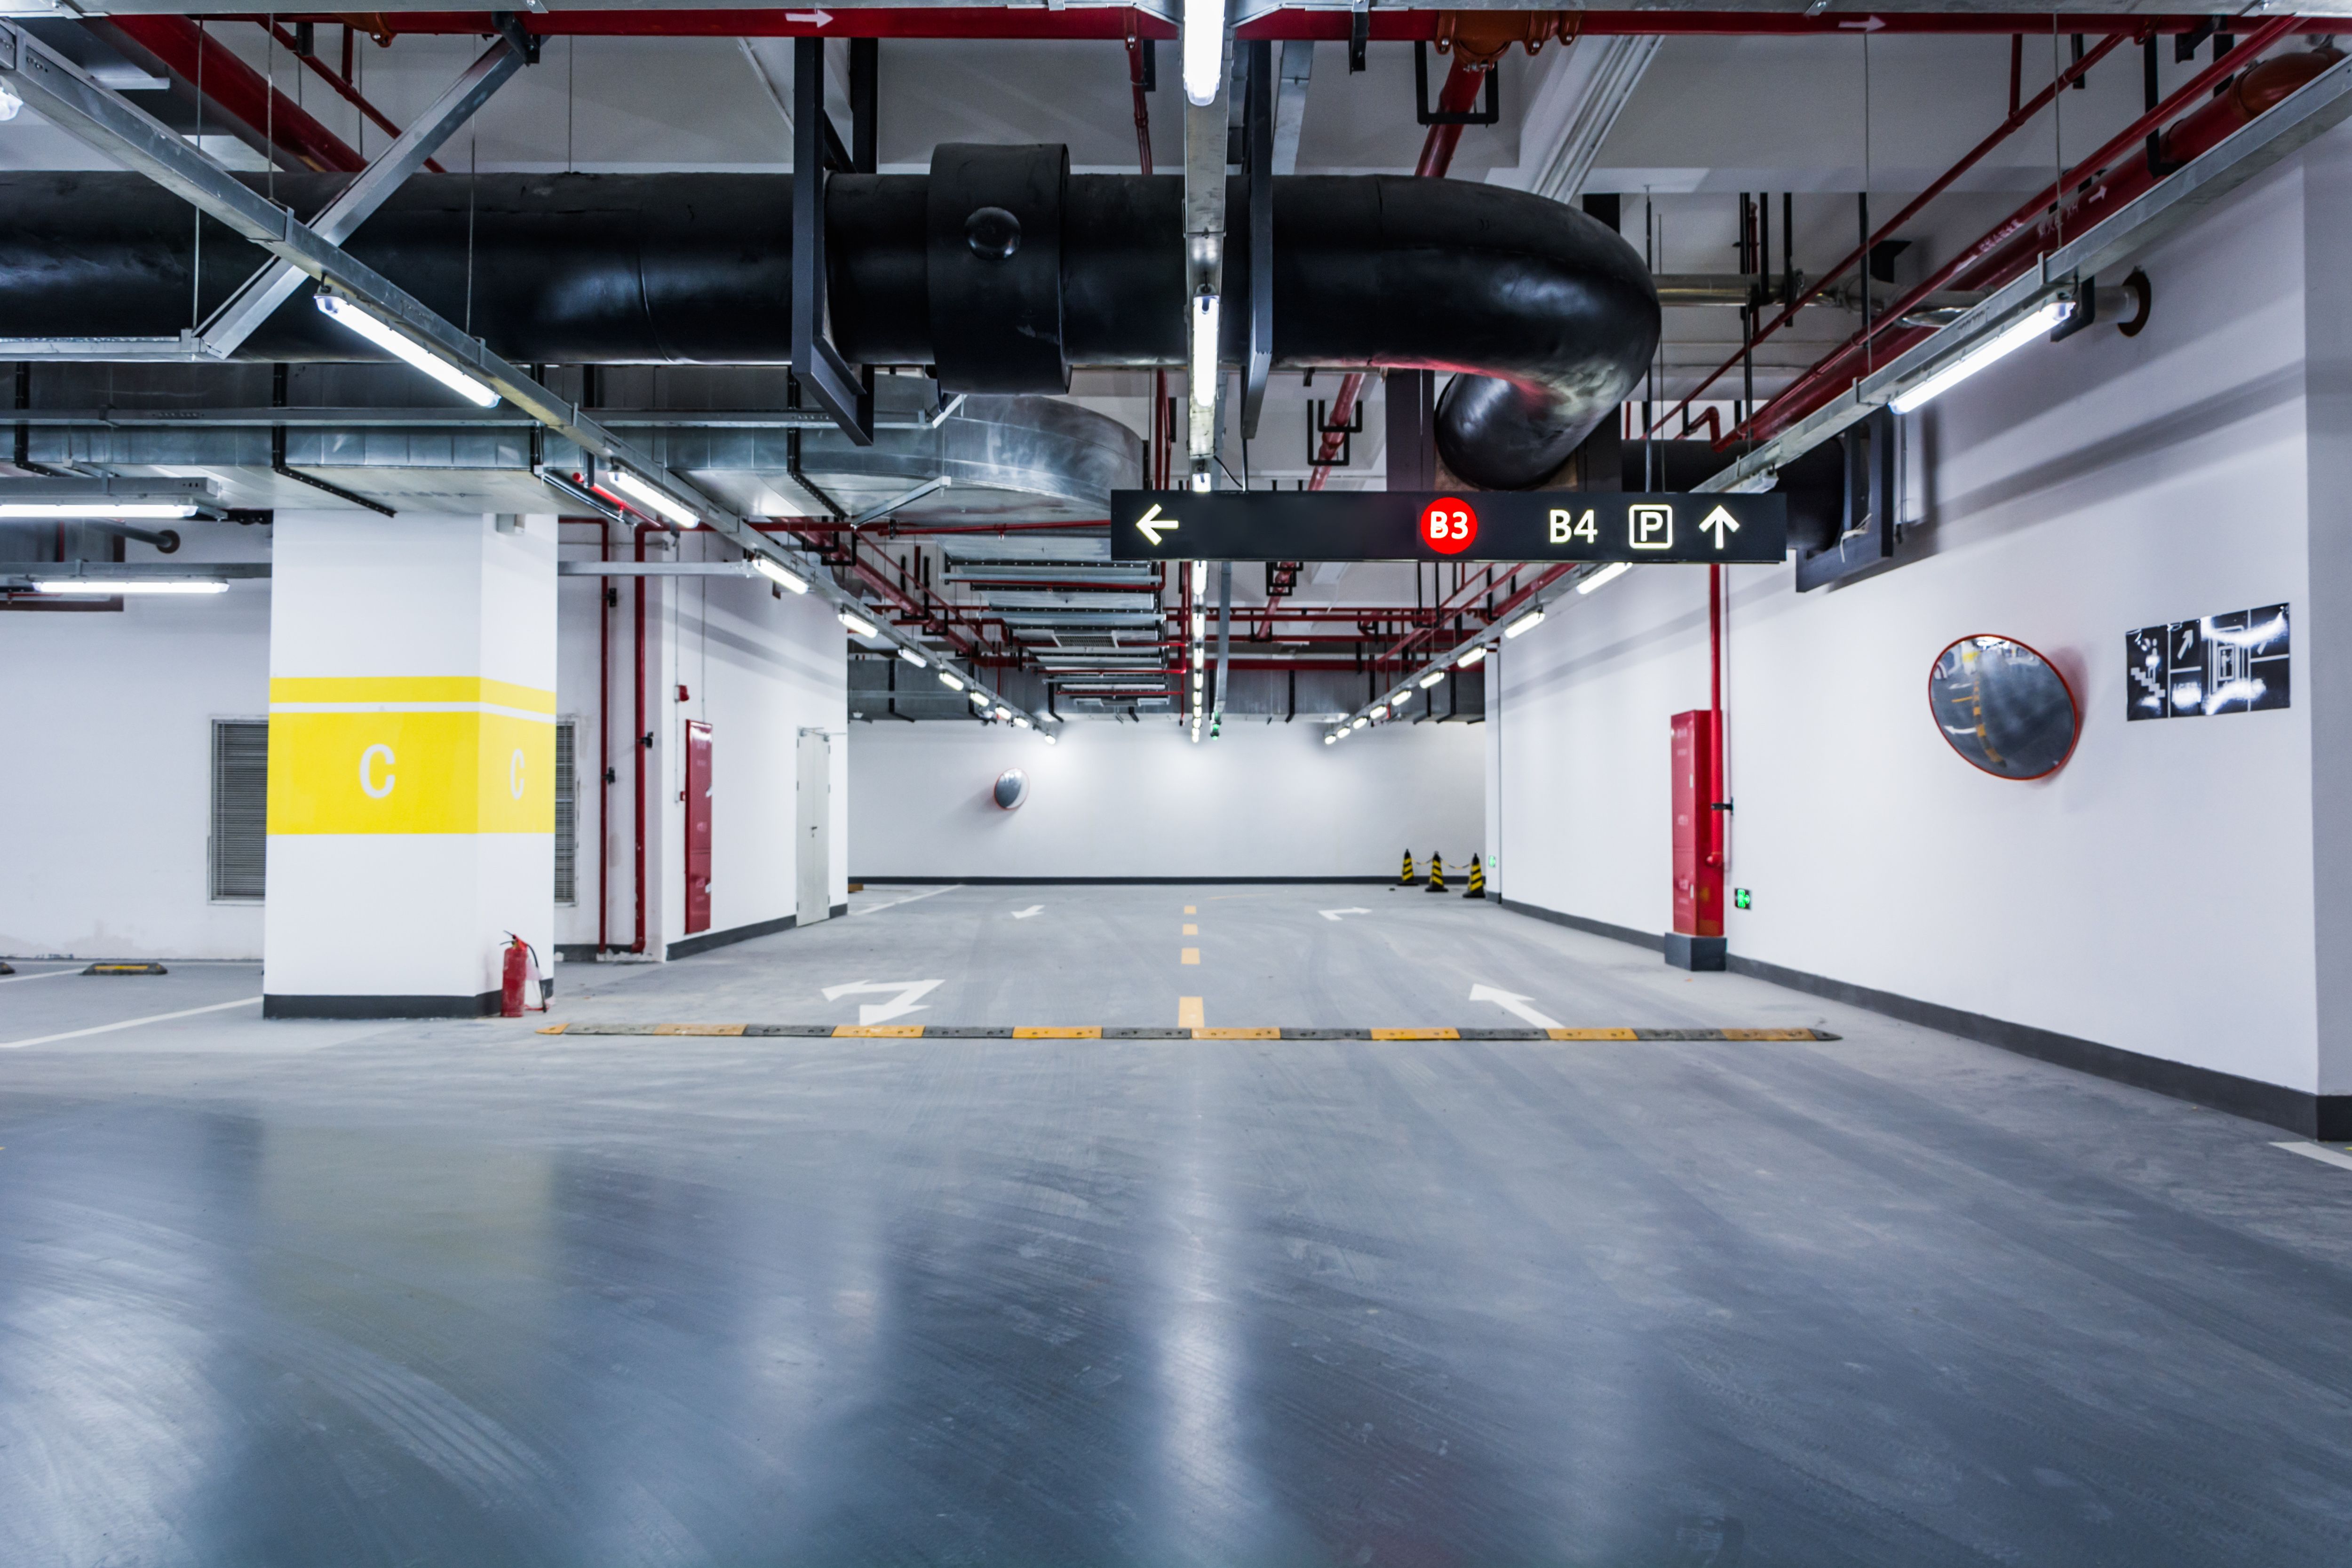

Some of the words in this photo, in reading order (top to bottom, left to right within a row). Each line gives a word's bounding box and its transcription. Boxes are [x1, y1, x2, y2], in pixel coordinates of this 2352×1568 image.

[1430, 511, 1468, 540] B3
[1550, 509, 1598, 543] B4
[1640, 511, 1663, 542] P
[359, 744, 396, 798] C
[509, 748, 524, 800] C
